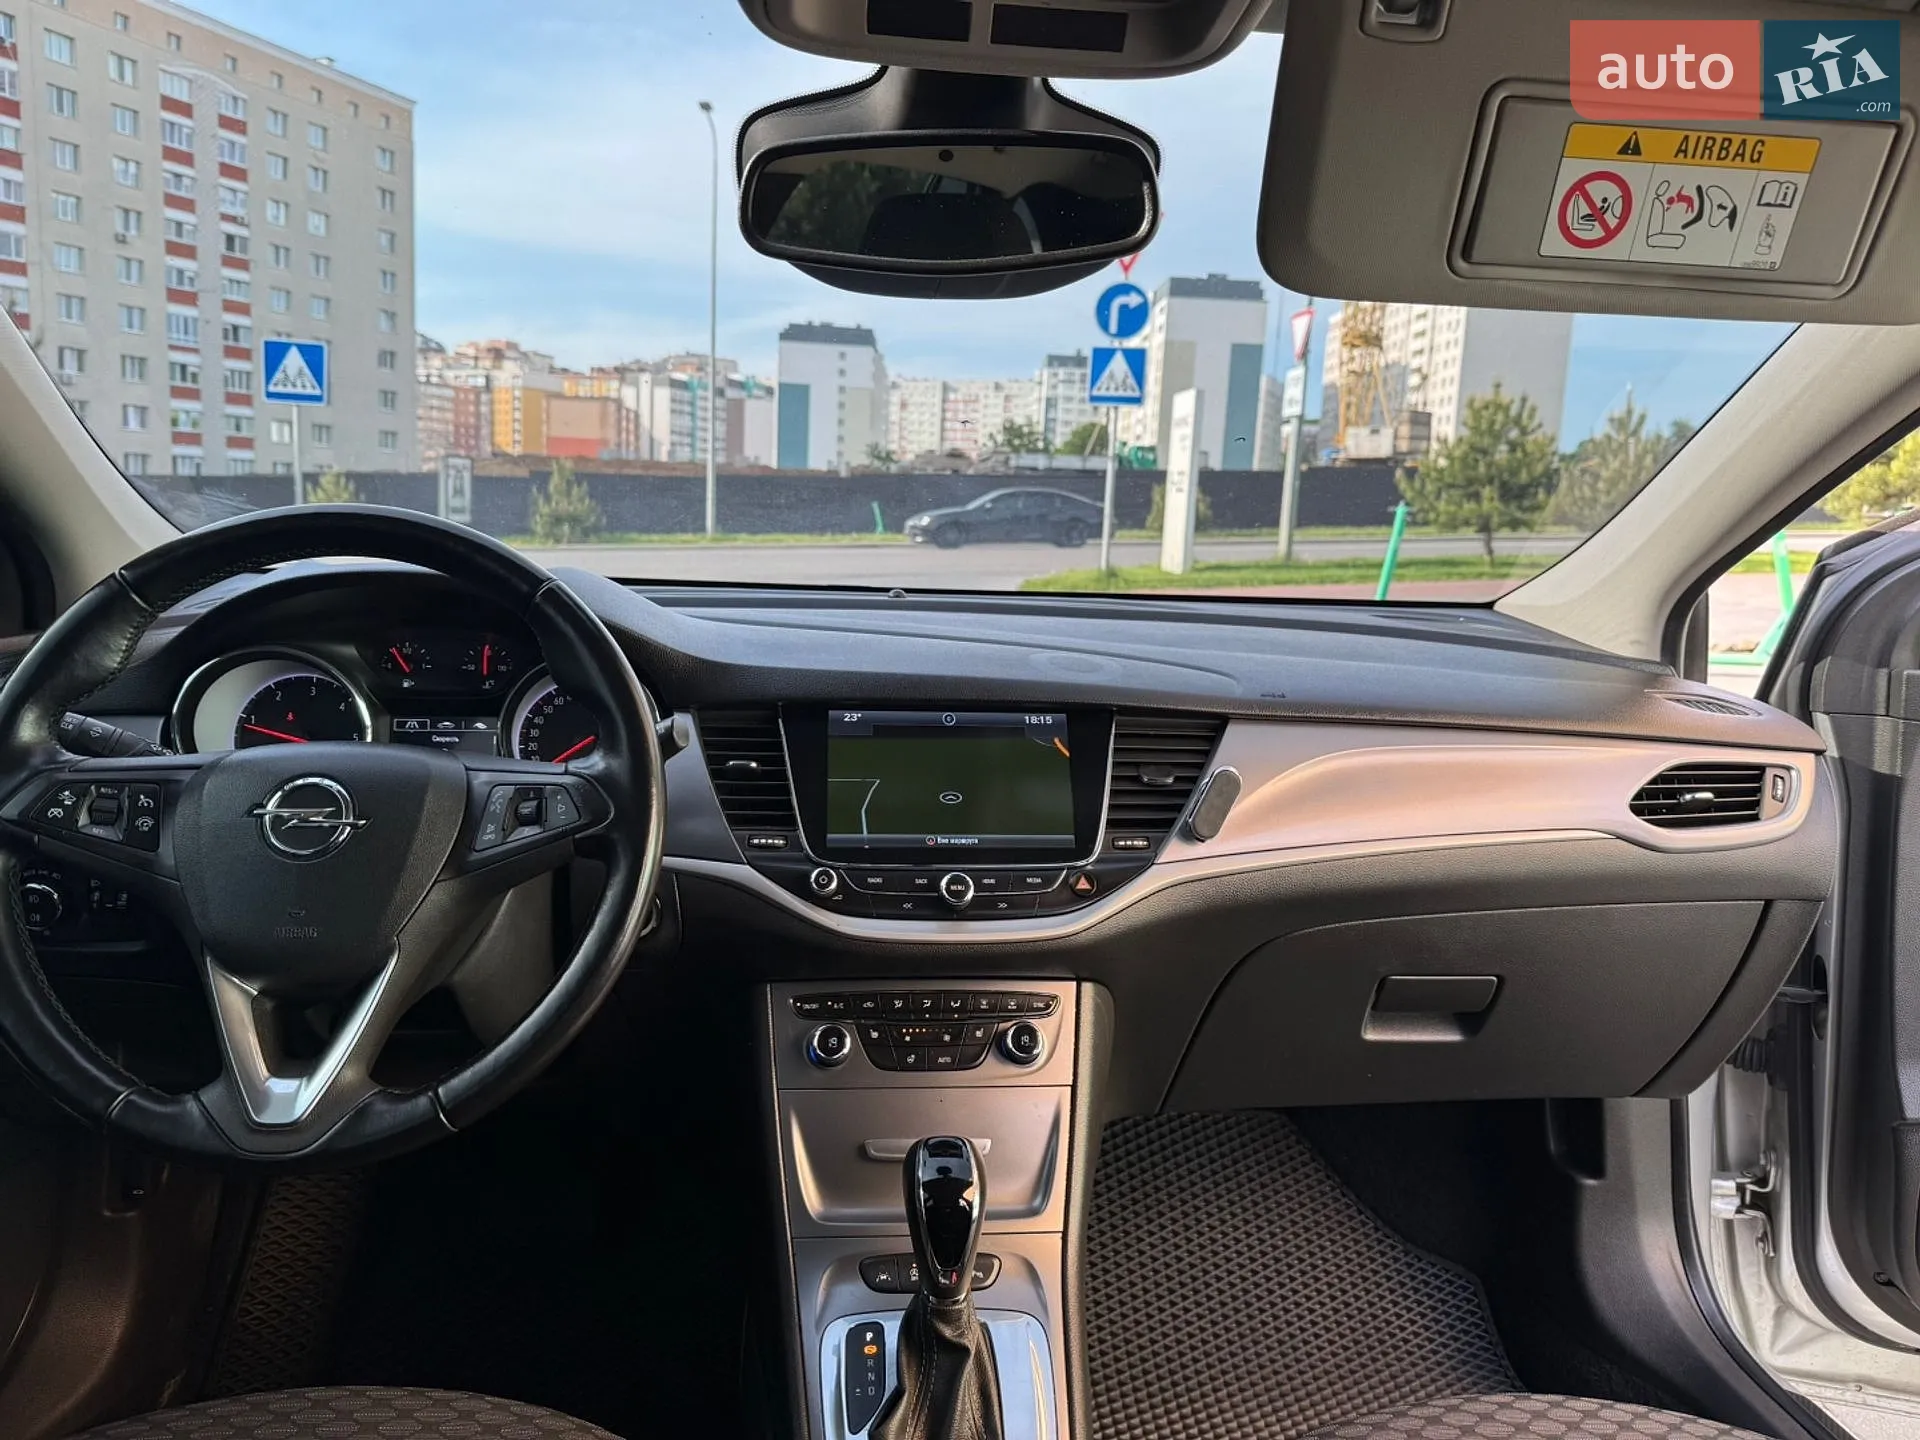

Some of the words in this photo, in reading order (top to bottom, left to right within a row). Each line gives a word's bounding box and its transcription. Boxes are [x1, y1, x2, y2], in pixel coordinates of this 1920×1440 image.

[1674, 134, 1765, 163] AIRBAG
[276, 691, 282, 701] 2
[310, 686, 316, 696] 3
[553, 697, 564, 705] 60
[339, 702, 346, 712] 4
[543, 706, 553, 714] 50
[251, 715, 256, 725] 1
[533, 716, 544, 725] 40
[1024, 715, 1053, 725] 18:15
[529, 728, 540, 738] 30
[528, 742, 538, 751] 20
[866, 1331, 873, 1342] P
[867, 1359, 875, 1367] R
[868, 1372, 875, 1381] N
[868, 1387, 875, 1396] D
